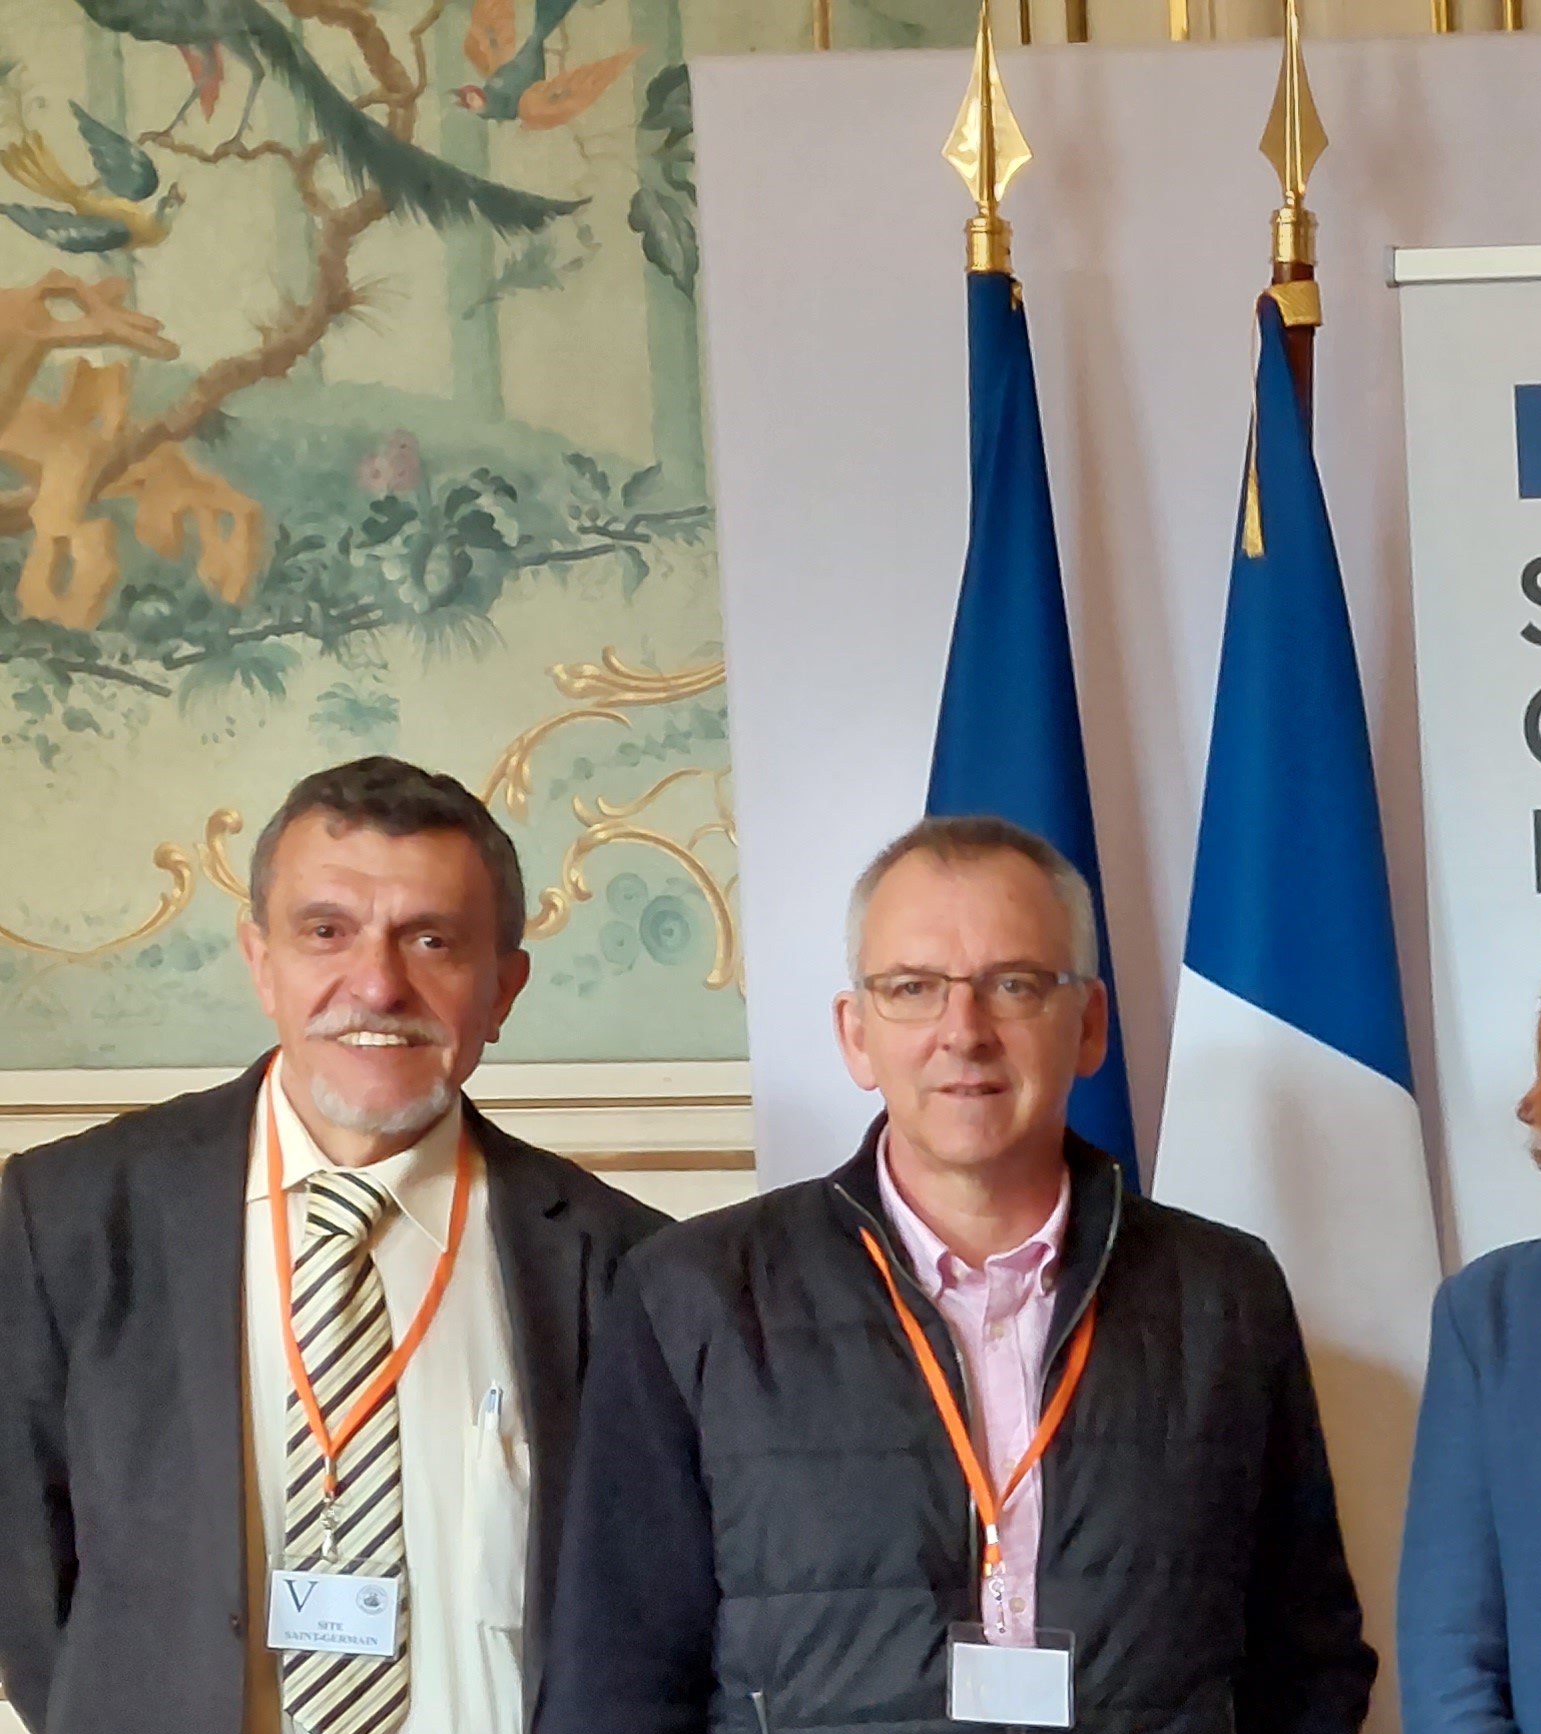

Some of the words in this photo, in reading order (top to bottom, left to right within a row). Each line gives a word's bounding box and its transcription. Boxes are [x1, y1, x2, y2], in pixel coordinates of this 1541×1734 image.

[282, 1578, 320, 1613] V
[317, 1621, 344, 1632] SITE
[284, 1630, 379, 1646] SAINT-GERMAIN
